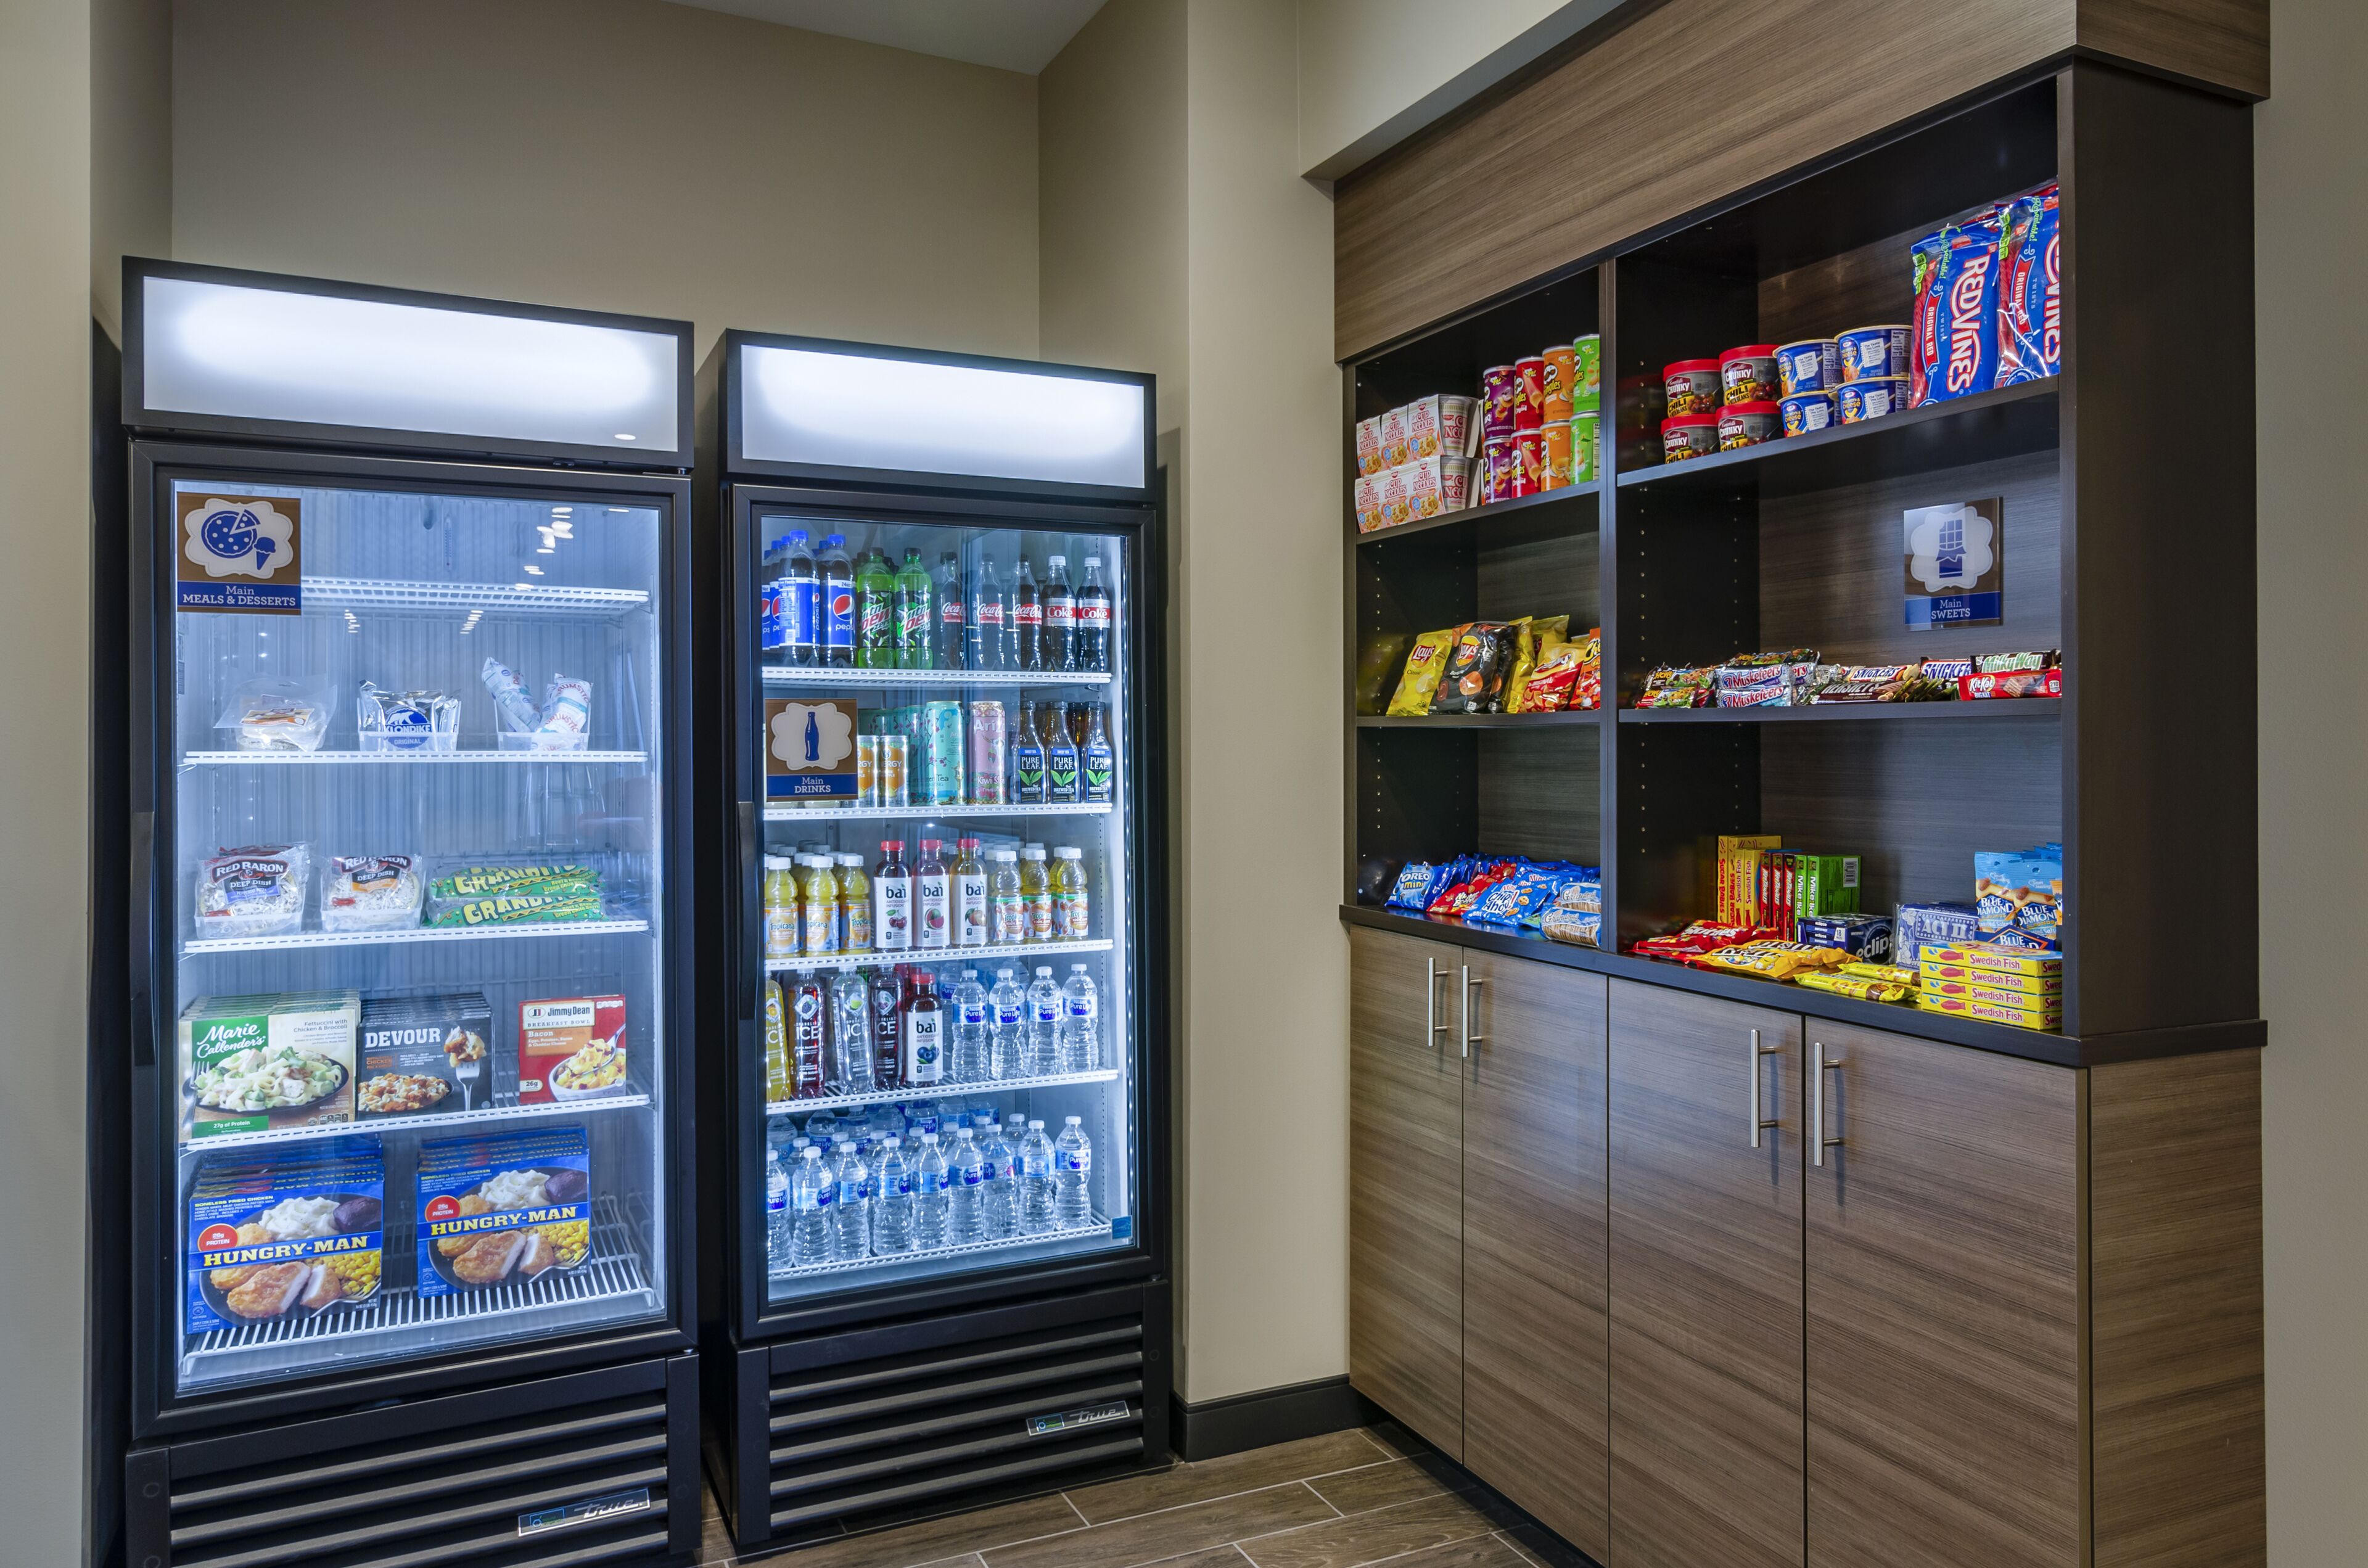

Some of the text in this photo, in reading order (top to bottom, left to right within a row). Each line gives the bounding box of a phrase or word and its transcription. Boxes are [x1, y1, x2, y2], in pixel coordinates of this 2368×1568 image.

[1950, 254, 1990, 311] RED
[1926, 306, 1935, 356] ORIGINAL RED
[1947, 306, 1981, 393] VINES
[1725, 369, 1751, 382] CHUNKY
[1667, 382, 1690, 394] CHUNKY
[1727, 385, 1748, 400] CHILI
[1668, 398, 1687, 413] CHILI
[1417, 411, 1429, 421] CUP
[1389, 421, 1400, 431] CUP
[1412, 417, 1434, 432] NOODLES
[1363, 431, 1373, 441] CUP
[1384, 427, 1405, 441] NOODLES
[1720, 425, 1743, 438] CHUNKY
[1359, 438, 1378, 451] NOODLES
[1666, 437, 1687, 449] CHUNKY
[1419, 470, 1431, 482] CUP
[1389, 478, 1402, 489] CUP
[1413, 477, 1436, 491] NOODLES
[1363, 486, 1374, 496] CUP
[1384, 485, 1407, 499] NOODLES
[1359, 493, 1379, 506] NOODLES
[226, 586, 254, 594] Main
[183, 594, 295, 606] MEALS & DESSERTS
[1940, 599, 1962, 609] Main
[1047, 607, 1073, 617] Coke
[1082, 608, 1107, 618] Coke
[1931, 608, 1970, 619] SWEETS
[1413, 646, 1434, 662] Lay's
[1981, 652, 2043, 673] Milky Way
[1724, 679, 1732, 689] 3
[1733, 665, 1782, 688] Musketeers
[1854, 668, 1898, 677] SNICKERS
[1724, 687, 1783, 707] 3 Musketeers
[217, 861, 284, 876] RED BARON
[345, 856, 367, 869] RED
[358, 870, 394, 881] DEEP DISH
[1401, 872, 1430, 882] OREO
[230, 880, 251, 889] DEEP
[923, 884, 943, 897] bai
[966, 884, 984, 896] bai
[1404, 881, 1424, 889] mini
[886, 885, 906, 898] bai
[1981, 898, 2001, 907] BLUE
[2022, 905, 2049, 916] BLUE
[1922, 916, 1967, 939] ACT II
[2000, 935, 2025, 946] BLUE
[1970, 953, 2020, 969] Swedish Fish
[1971, 971, 2022, 987] Swedish Fish
[1972, 988, 2023, 1004] Swedish Fish
[548, 1006, 590, 1016] Jimmy Dean
[1971, 1004, 2023, 1021] Swedish Fish
[796, 1025, 820, 1040] ICE
[916, 1021, 936, 1033] bai
[197, 1024, 260, 1045] Marie
[365, 1028, 441, 1048] DEVOUR
[197, 1036, 266, 1058] Callender's
[431, 1207, 576, 1236] HUNGRY-MAN
[204, 1236, 368, 1266] HUNGRY-MAN
[1069, 1409, 1120, 1423] true
[574, 1499, 639, 1519] true
